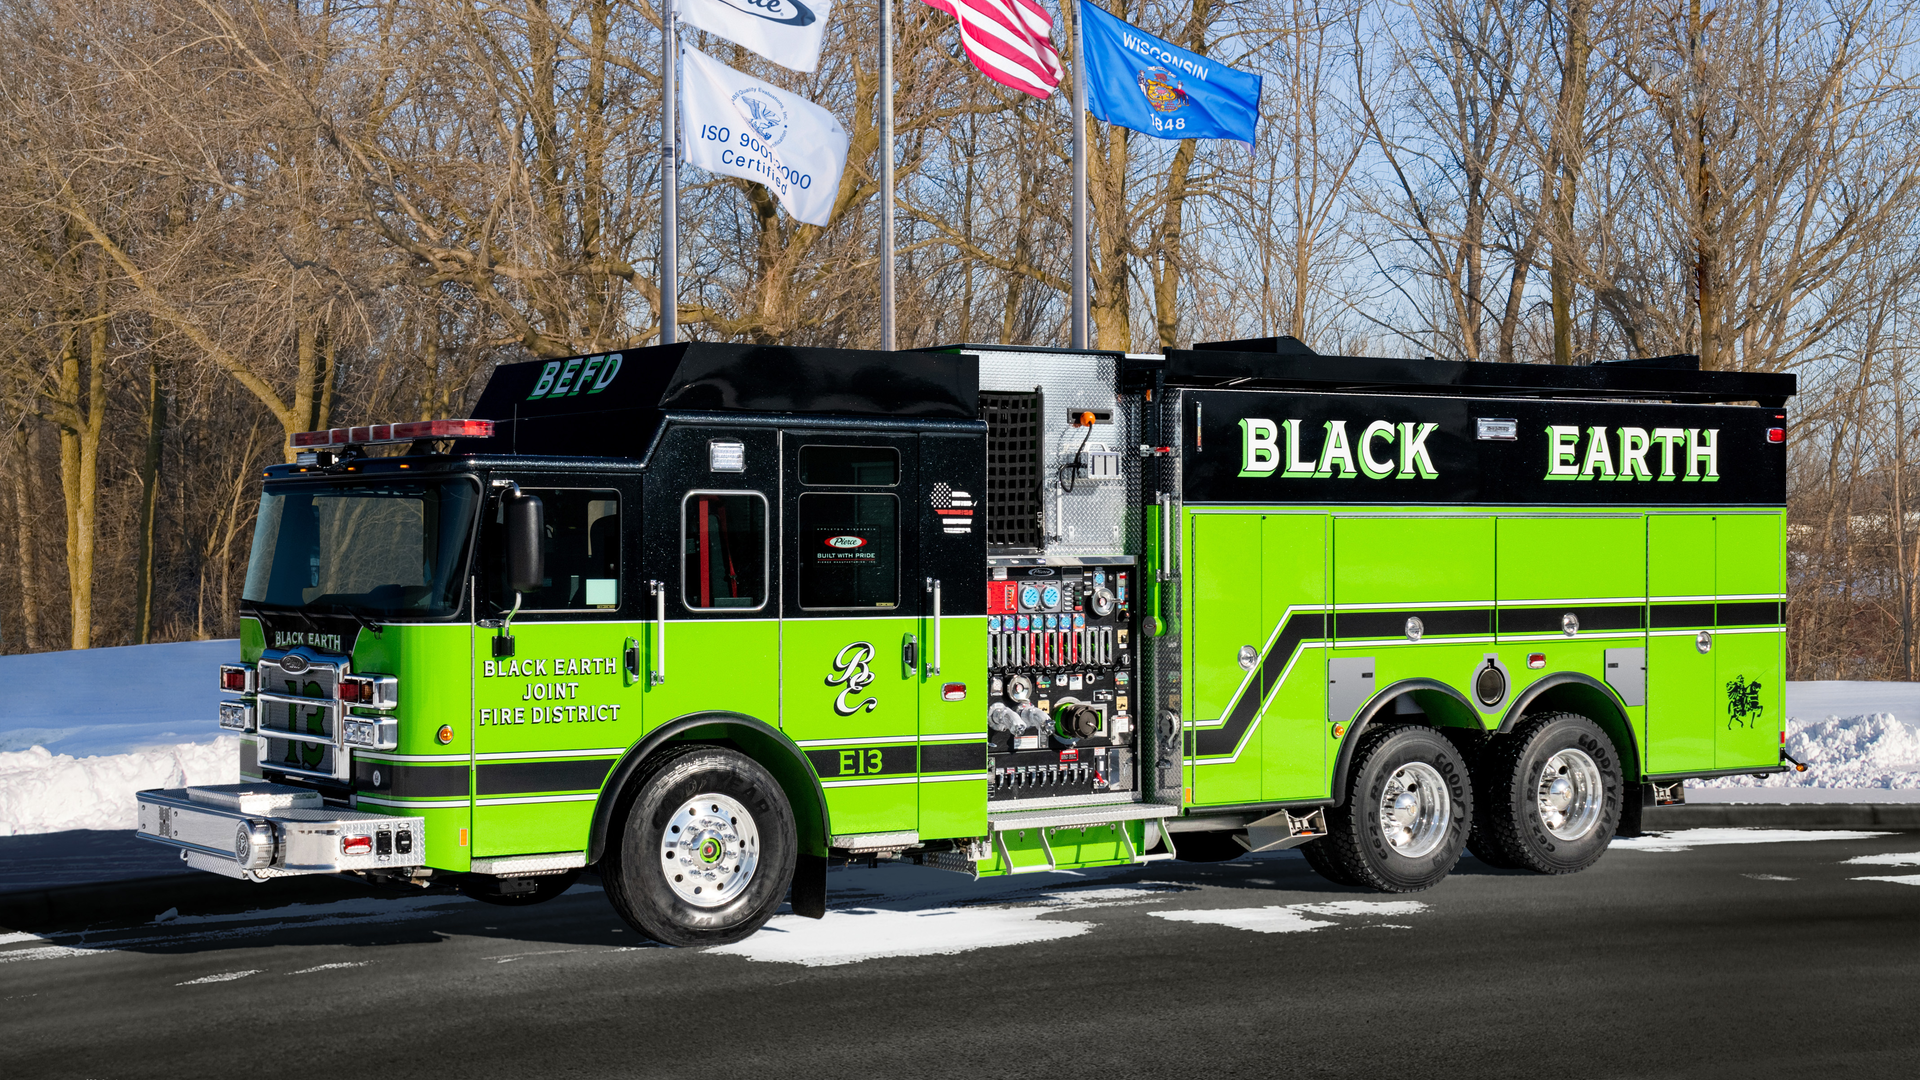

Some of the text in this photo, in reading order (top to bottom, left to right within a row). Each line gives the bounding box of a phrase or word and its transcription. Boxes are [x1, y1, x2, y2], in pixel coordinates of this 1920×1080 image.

[1123, 31, 1209, 82] WISCONSIN
[1150, 113, 1185, 131] 1848
[701, 124, 730, 143] ISO
[721, 149, 787, 196] Certified
[526, 353, 623, 400] BEFD
[1237, 417, 1720, 482] BLACK EARTH
[275, 630, 341, 652] BLACK EARTH
[483, 657, 617, 677] BLACK EARTH
[522, 682, 579, 701] JOINT
[479, 704, 621, 726] FIRE DISTRICT
[839, 749, 883, 776] E13
